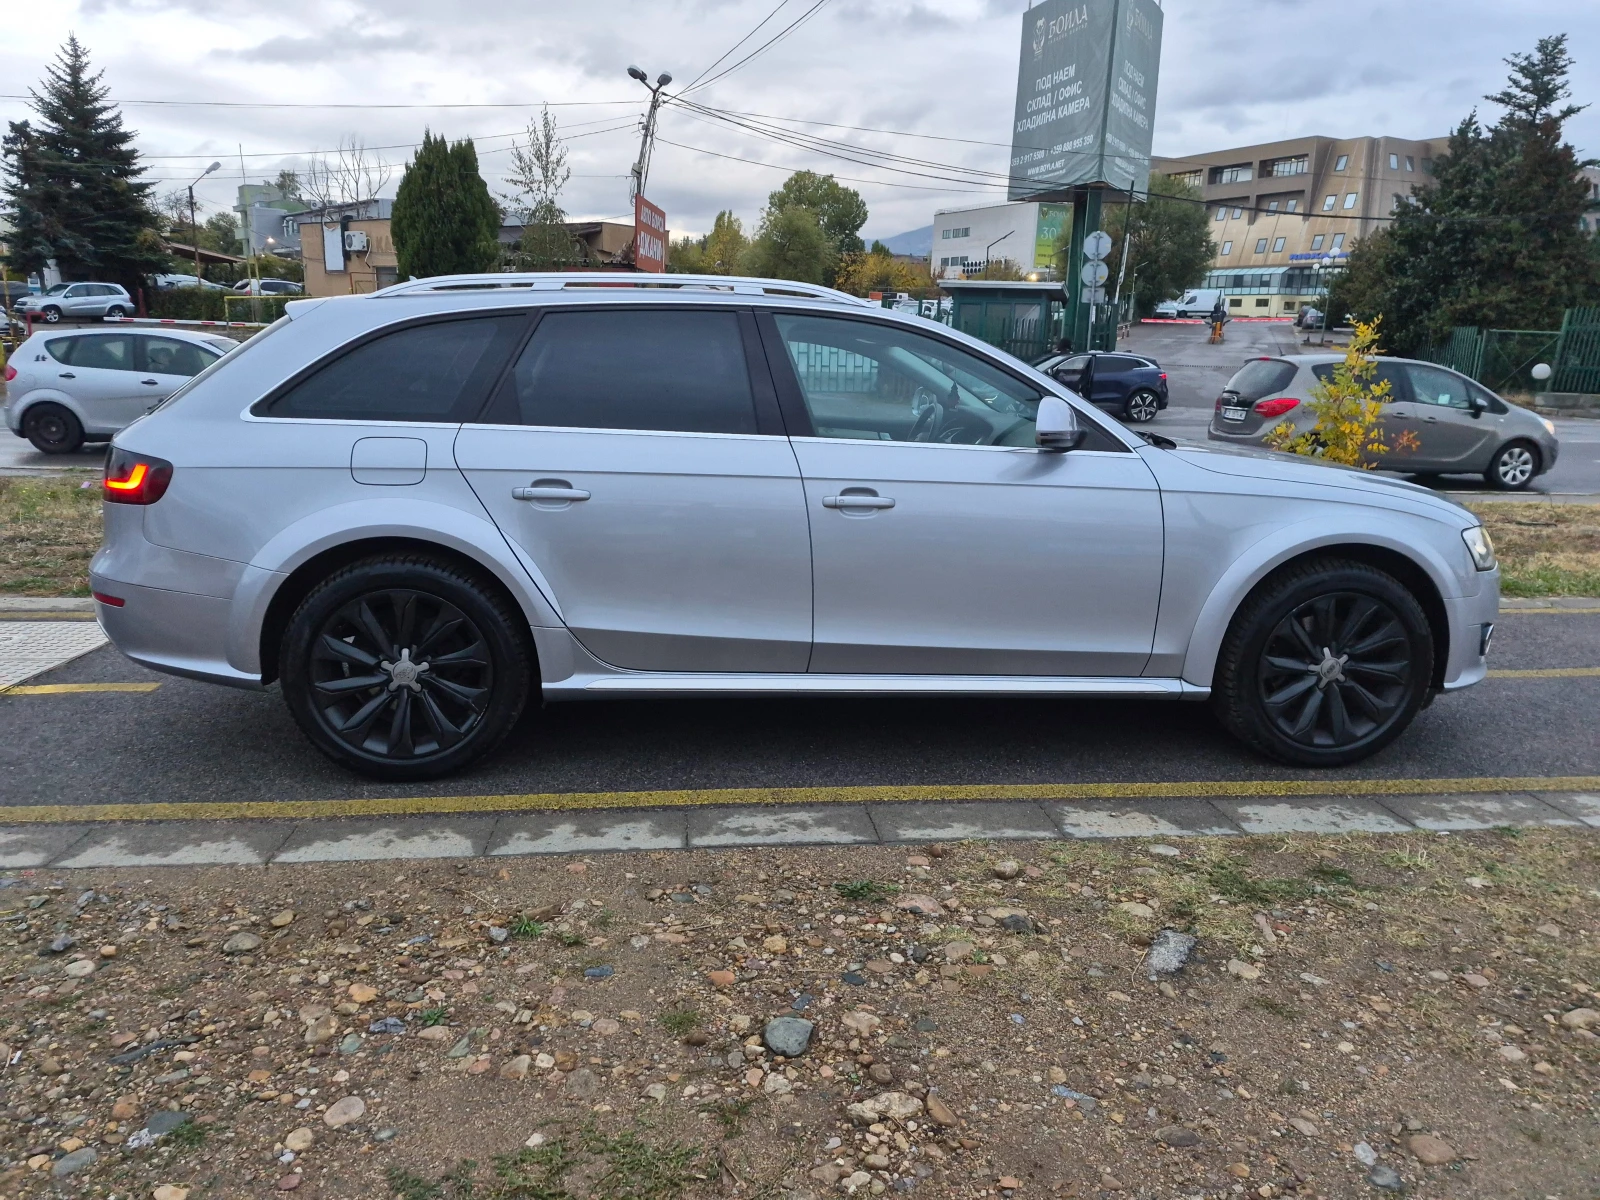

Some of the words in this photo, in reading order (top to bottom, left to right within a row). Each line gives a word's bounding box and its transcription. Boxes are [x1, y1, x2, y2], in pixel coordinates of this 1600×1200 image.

[1048, 4, 1088, 39] БОИЛА
[1035, 74, 1052, 92] ПОД
[1053, 63, 1076, 85] НАЕМ
[1026, 92, 1052, 113] СКЛАД
[1058, 80, 1083, 101] ОФИС
[1016, 108, 1057, 133] ХЛАДИЛНА
[1057, 96, 1091, 120] КАМЕРА
